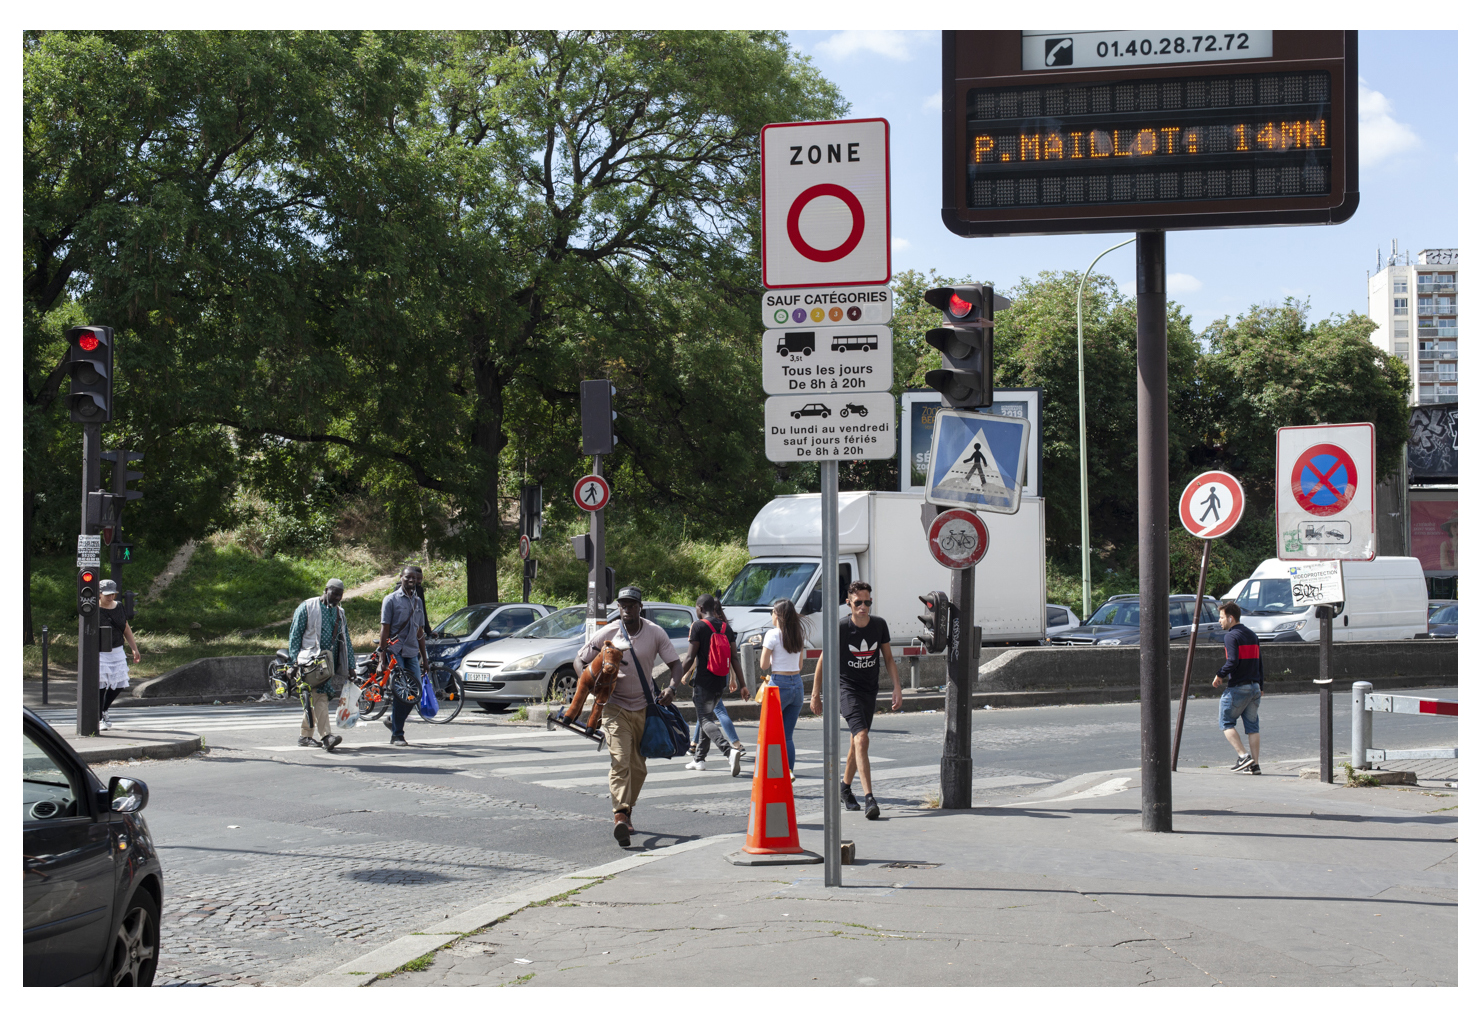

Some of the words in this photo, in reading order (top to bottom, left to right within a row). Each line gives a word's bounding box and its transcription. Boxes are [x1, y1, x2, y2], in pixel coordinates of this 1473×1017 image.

[1096, 32, 1250, 58] 01.40.28.72.72
[975, 126, 1198, 163] P.MAILLOT:
[789, 142, 860, 165] ZONE
[767, 295, 801, 307] SAUF
[804, 291, 887, 305] CATÉGORIES
[789, 354, 803, 363] 3,5t
[782, 365, 812, 376] Tous
[816, 365, 835, 375] les
[839, 364, 873, 377] jours
[789, 379, 806, 390] De
[810, 379, 826, 389] 8h
[830, 378, 838, 389] à
[842, 378, 866, 388] 20h
[771, 426, 786, 435] Du
[790, 425, 818, 435] lundi
[839, 423, 889, 433] vendredi
[783, 437, 807, 446] sauf
[811, 436, 840, 447] jours
[844, 435, 877, 445] fériés
[797, 447, 812, 456] De
[815, 447, 829, 456] 8h
[833, 447, 839, 455] à
[843, 446, 864, 455] 20h
[1293, 570, 1338, 580] VIDEOPROTECTION
[847, 659, 876, 669] adidas
